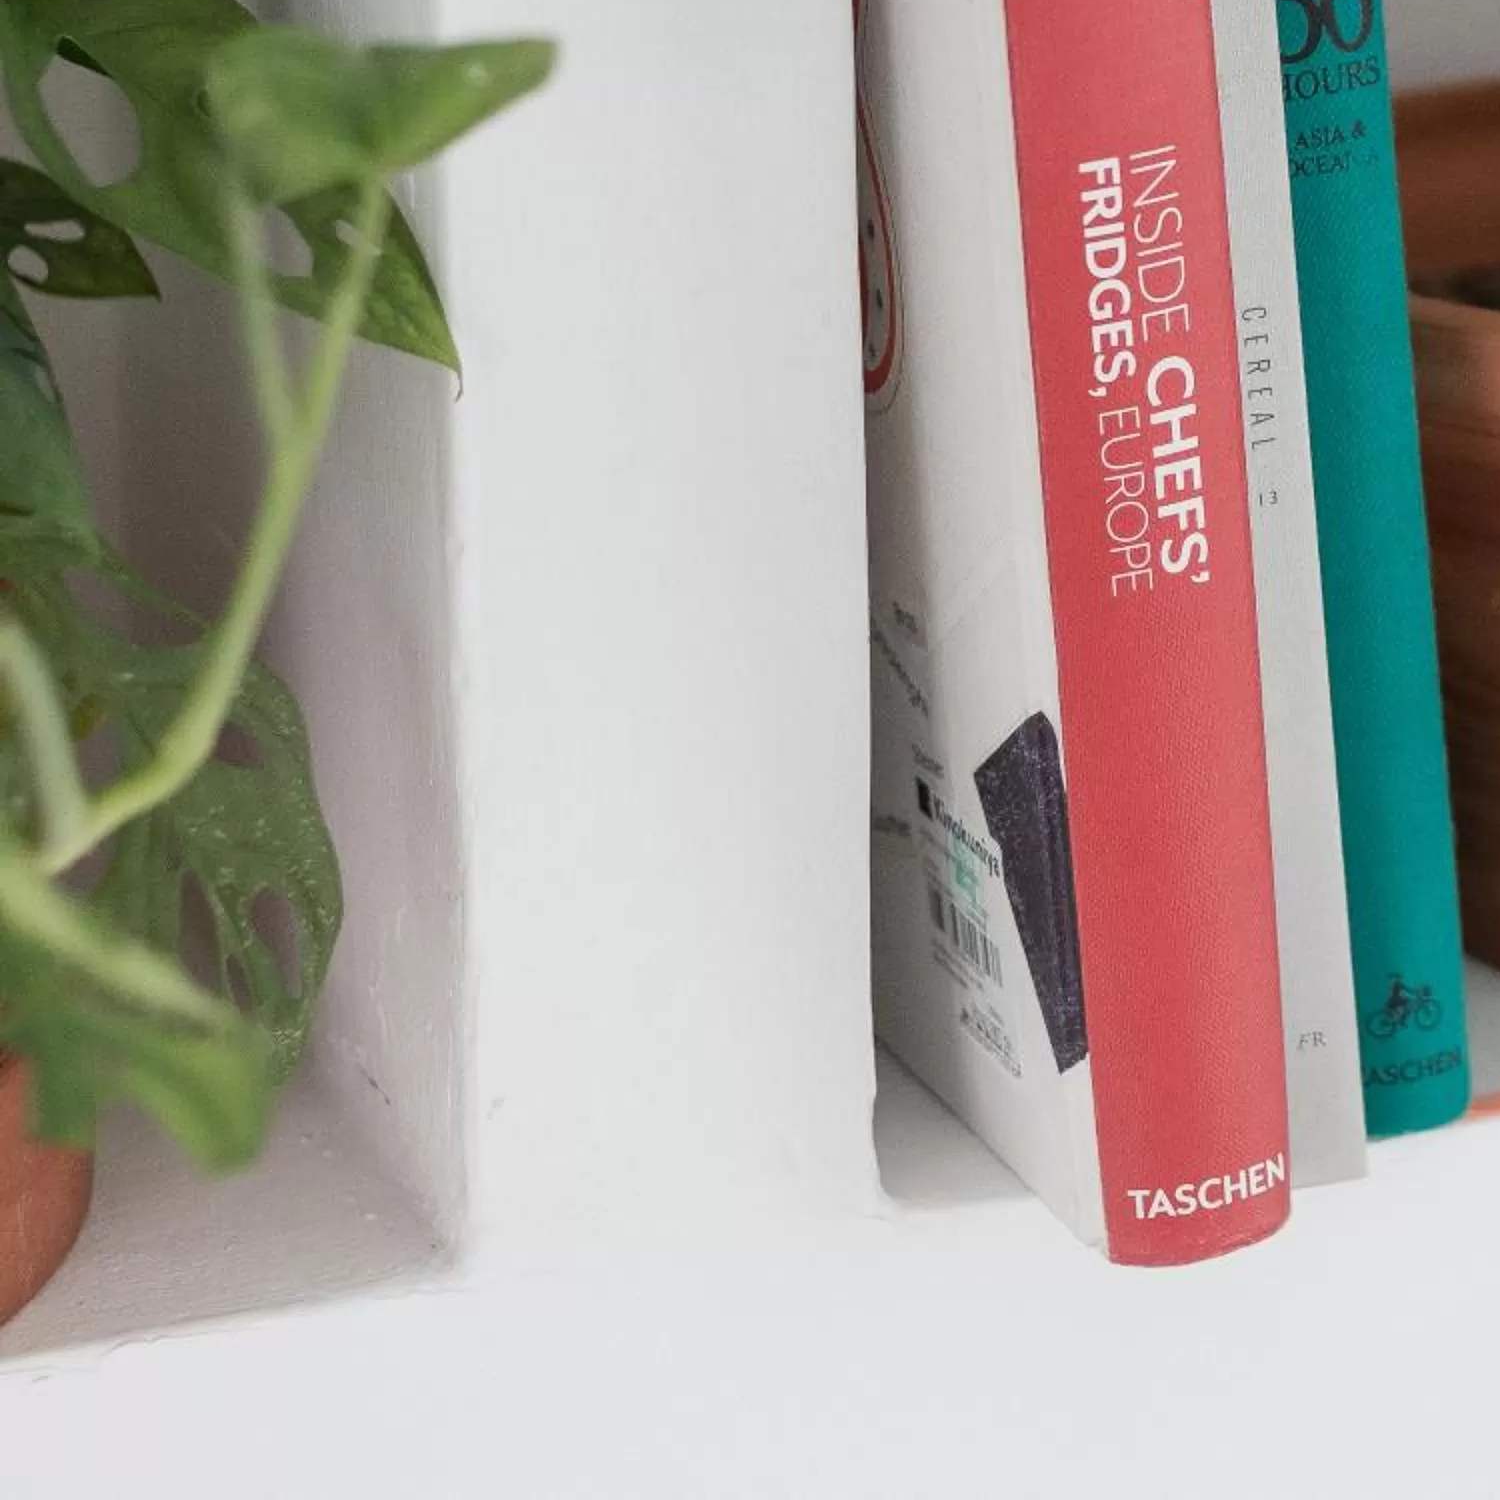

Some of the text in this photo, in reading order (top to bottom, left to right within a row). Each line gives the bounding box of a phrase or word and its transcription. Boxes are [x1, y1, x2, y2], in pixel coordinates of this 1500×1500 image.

[1295, 119, 1367, 150] ASIA &
[1129, 145, 1190, 342] INSIDE
[1078, 157, 1154, 597] FRIDGES, EUROPE
[1240, 306, 1278, 452] CEREAL
[1361, 1045, 1463, 1088] ASCHEN
[1127, 1152, 1286, 1220] TASCHEN
